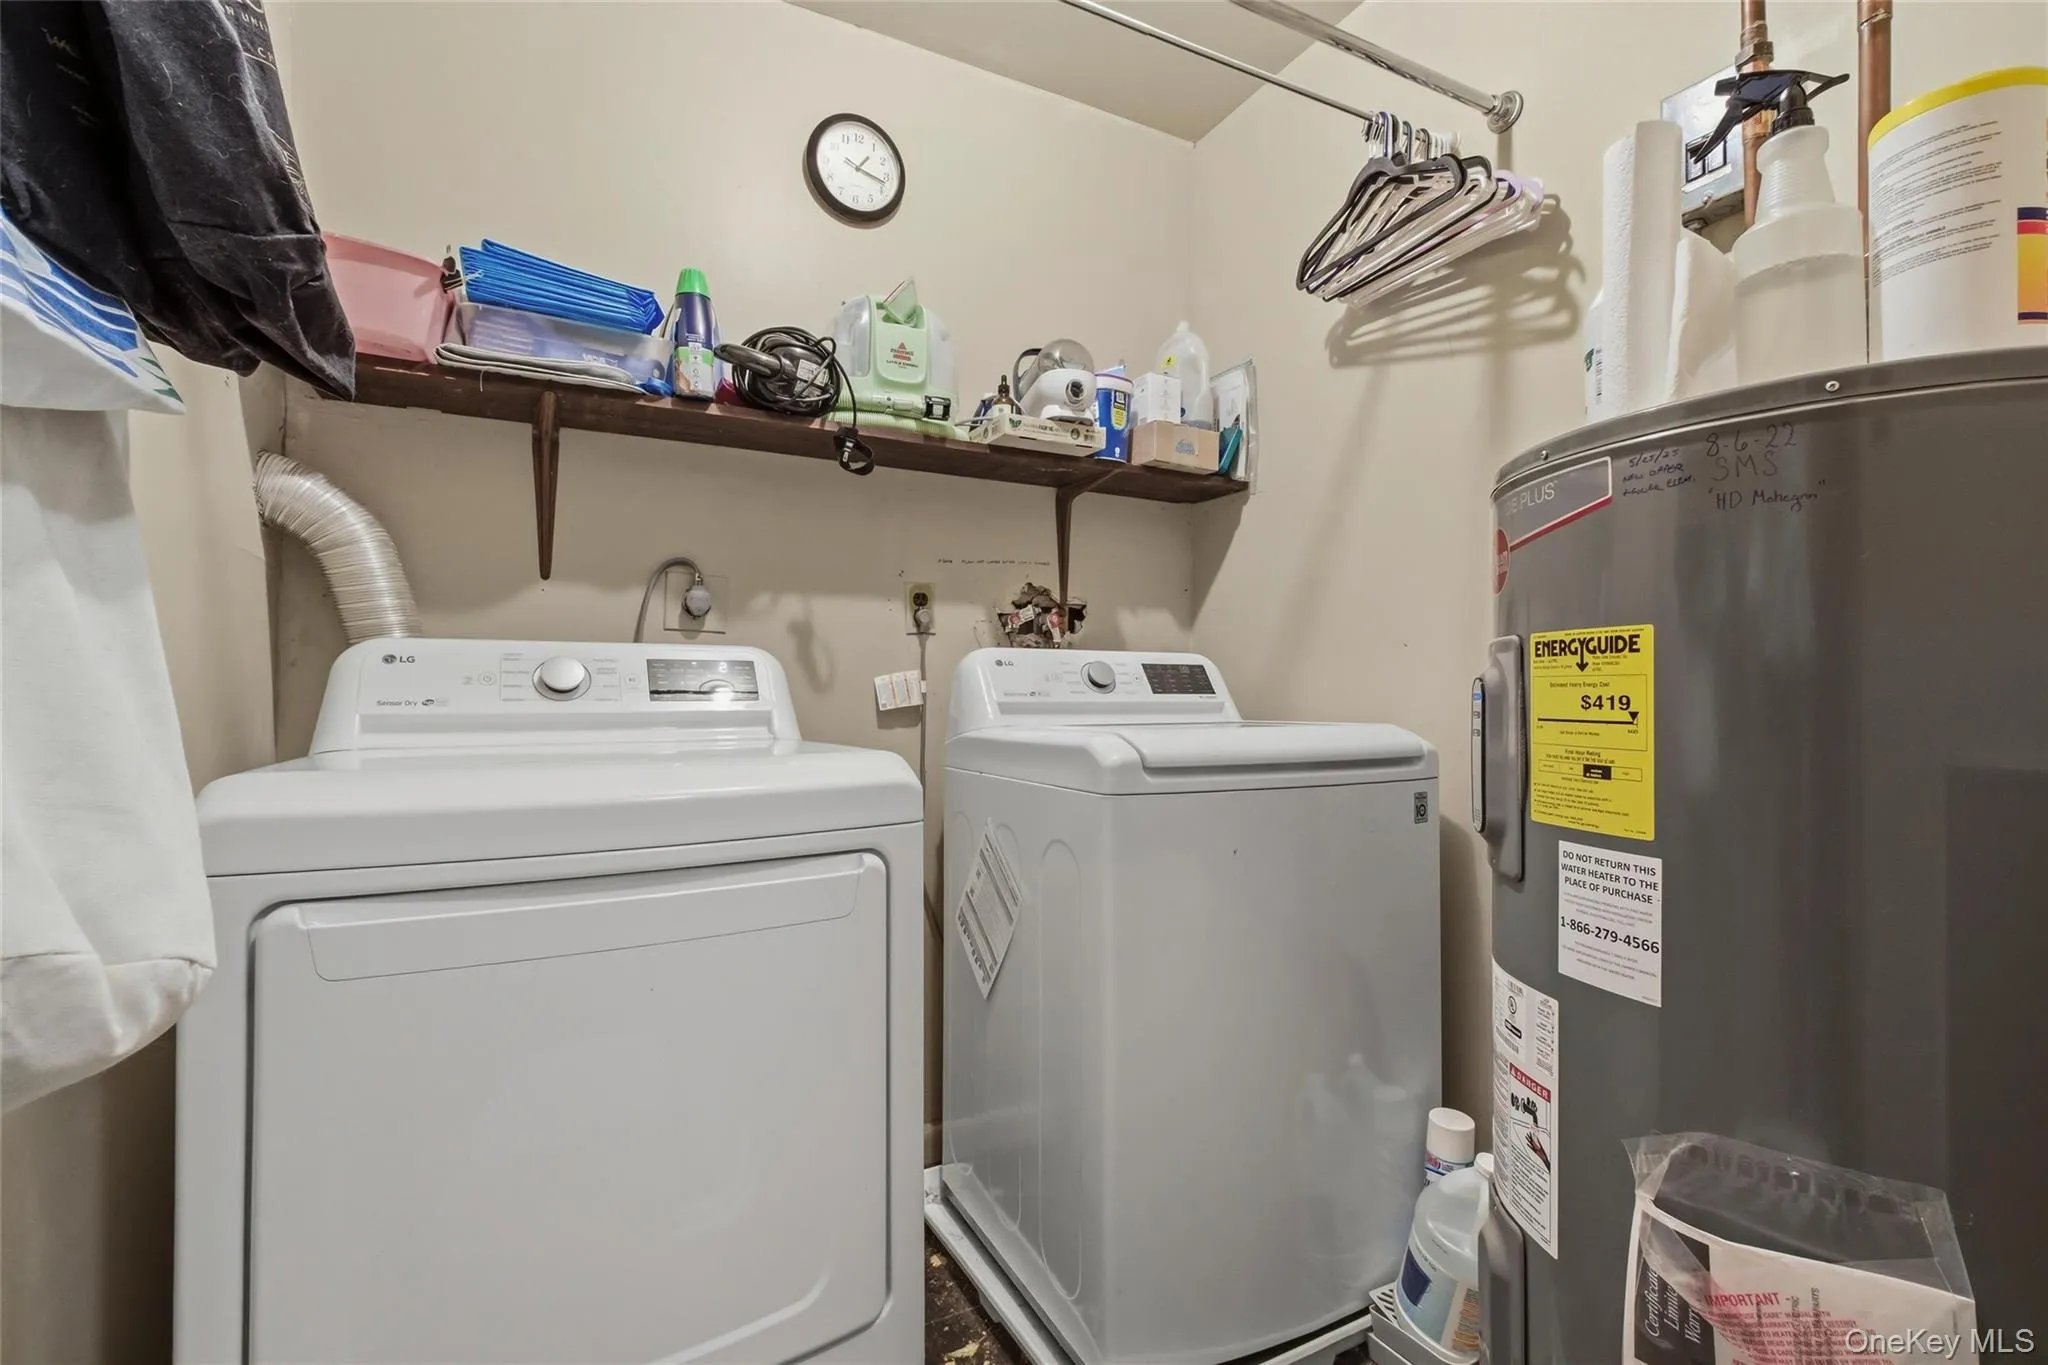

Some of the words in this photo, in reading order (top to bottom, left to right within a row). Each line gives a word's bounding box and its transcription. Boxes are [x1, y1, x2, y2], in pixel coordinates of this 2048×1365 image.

[842, 134, 850, 144] 11
[854, 133, 864, 144] 12
[880, 156, 887, 166] 2
[1704, 422, 1798, 457] 8-6-22
[1711, 449, 1779, 482] SMS
[1520, 481, 1555, 510] PLUS
[1534, 634, 1640, 659] ENERGYGUIDE
[404, 700, 418, 708] Dry
[1580, 694, 1632, 712] $419
[1562, 850, 1574, 860] DO
[1576, 853, 1593, 864] NOT
[1594, 857, 1631, 872] RETURN
[1633, 864, 1656, 876] THIS
[1560, 862, 1586, 876] WATER
[1588, 869, 1620, 884] HEATER
[1623, 876, 1636, 887] TO
[1639, 880, 1659, 892] THE
[1564, 876, 1587, 890] PLACE
[1588, 882, 1600, 892] OF
[1602, 886, 1654, 905] PURCHASE
[1560, 916, 1660, 954] 1-866-279-4566
[1514, 1072, 1549, 1099] DANGER
[1664, 1285, 1680, 1331] Limite
[1704, 1292, 1780, 1307] IMPORTANT
[1684, 1307, 1702, 1344] Warr
